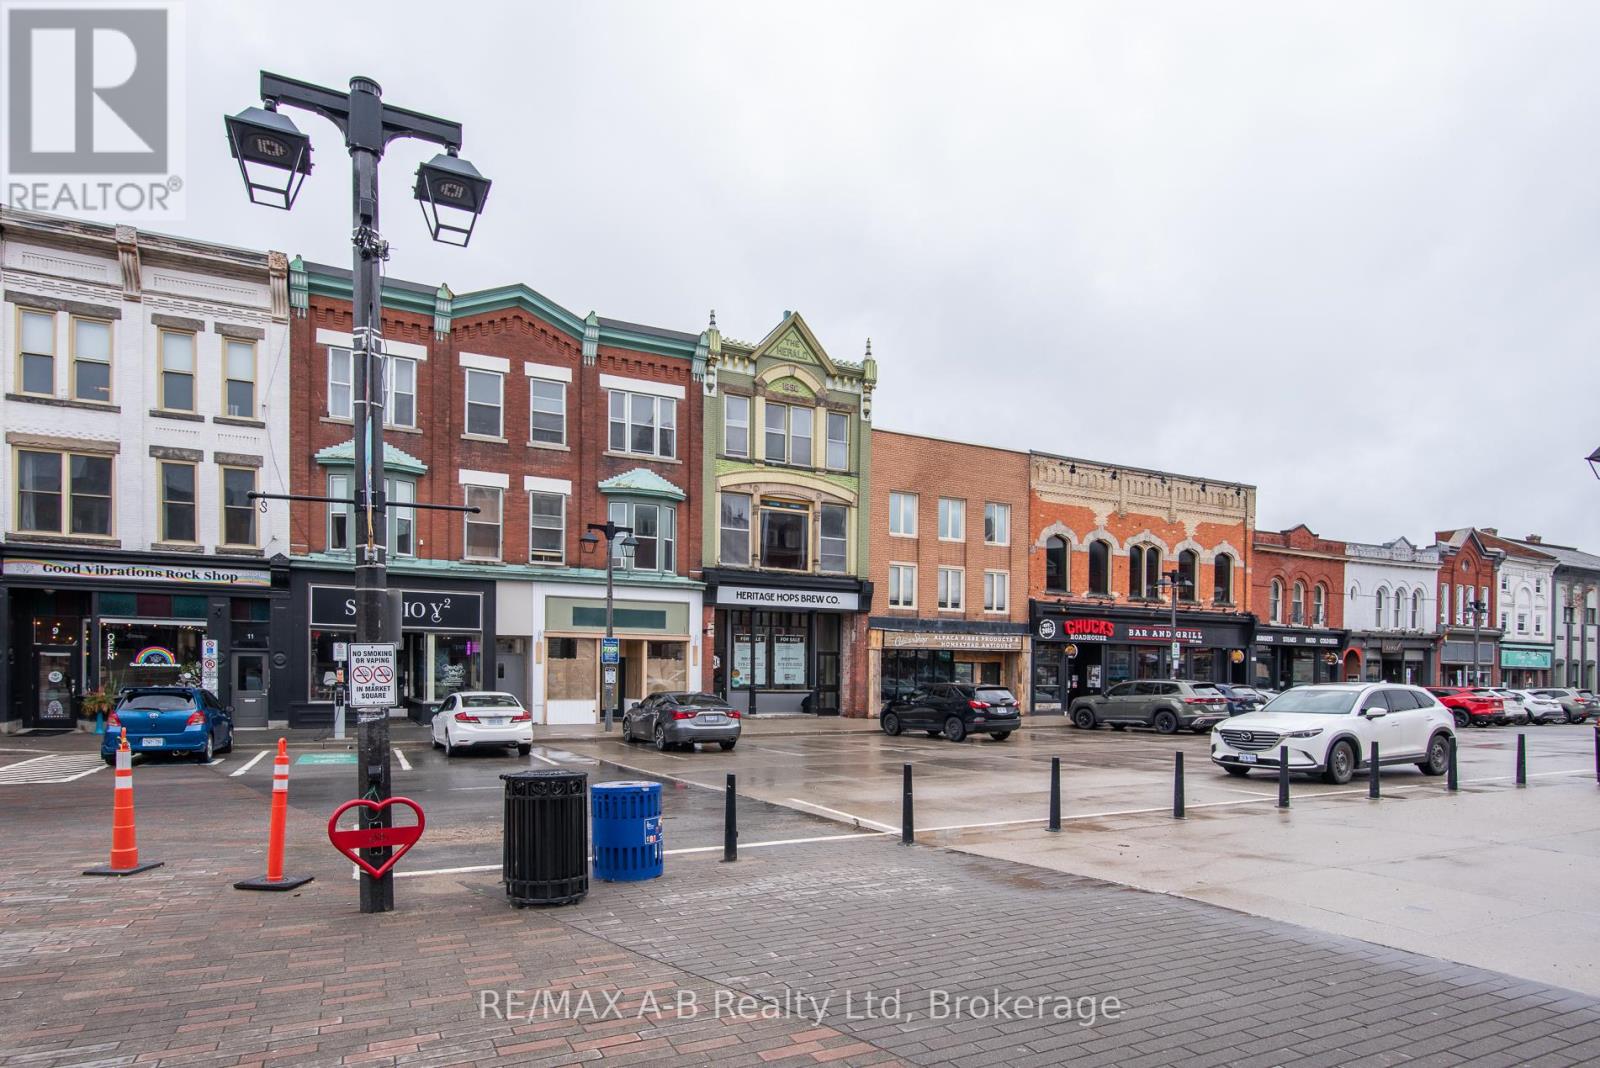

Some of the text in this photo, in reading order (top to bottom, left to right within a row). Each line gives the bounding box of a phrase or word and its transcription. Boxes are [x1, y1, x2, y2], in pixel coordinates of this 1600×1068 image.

[786, 339, 800, 348] THE
[777, 345, 807, 360] HERALD
[42, 563, 238, 584] Good Vibrations Rock Shop
[736, 591, 840, 604] HERITAGE HOPS BREW CO.
[345, 598, 426, 618] SIO
[1128, 628, 1203, 639] BAR AND GRILL
[107, 632, 115, 660] OPEN
